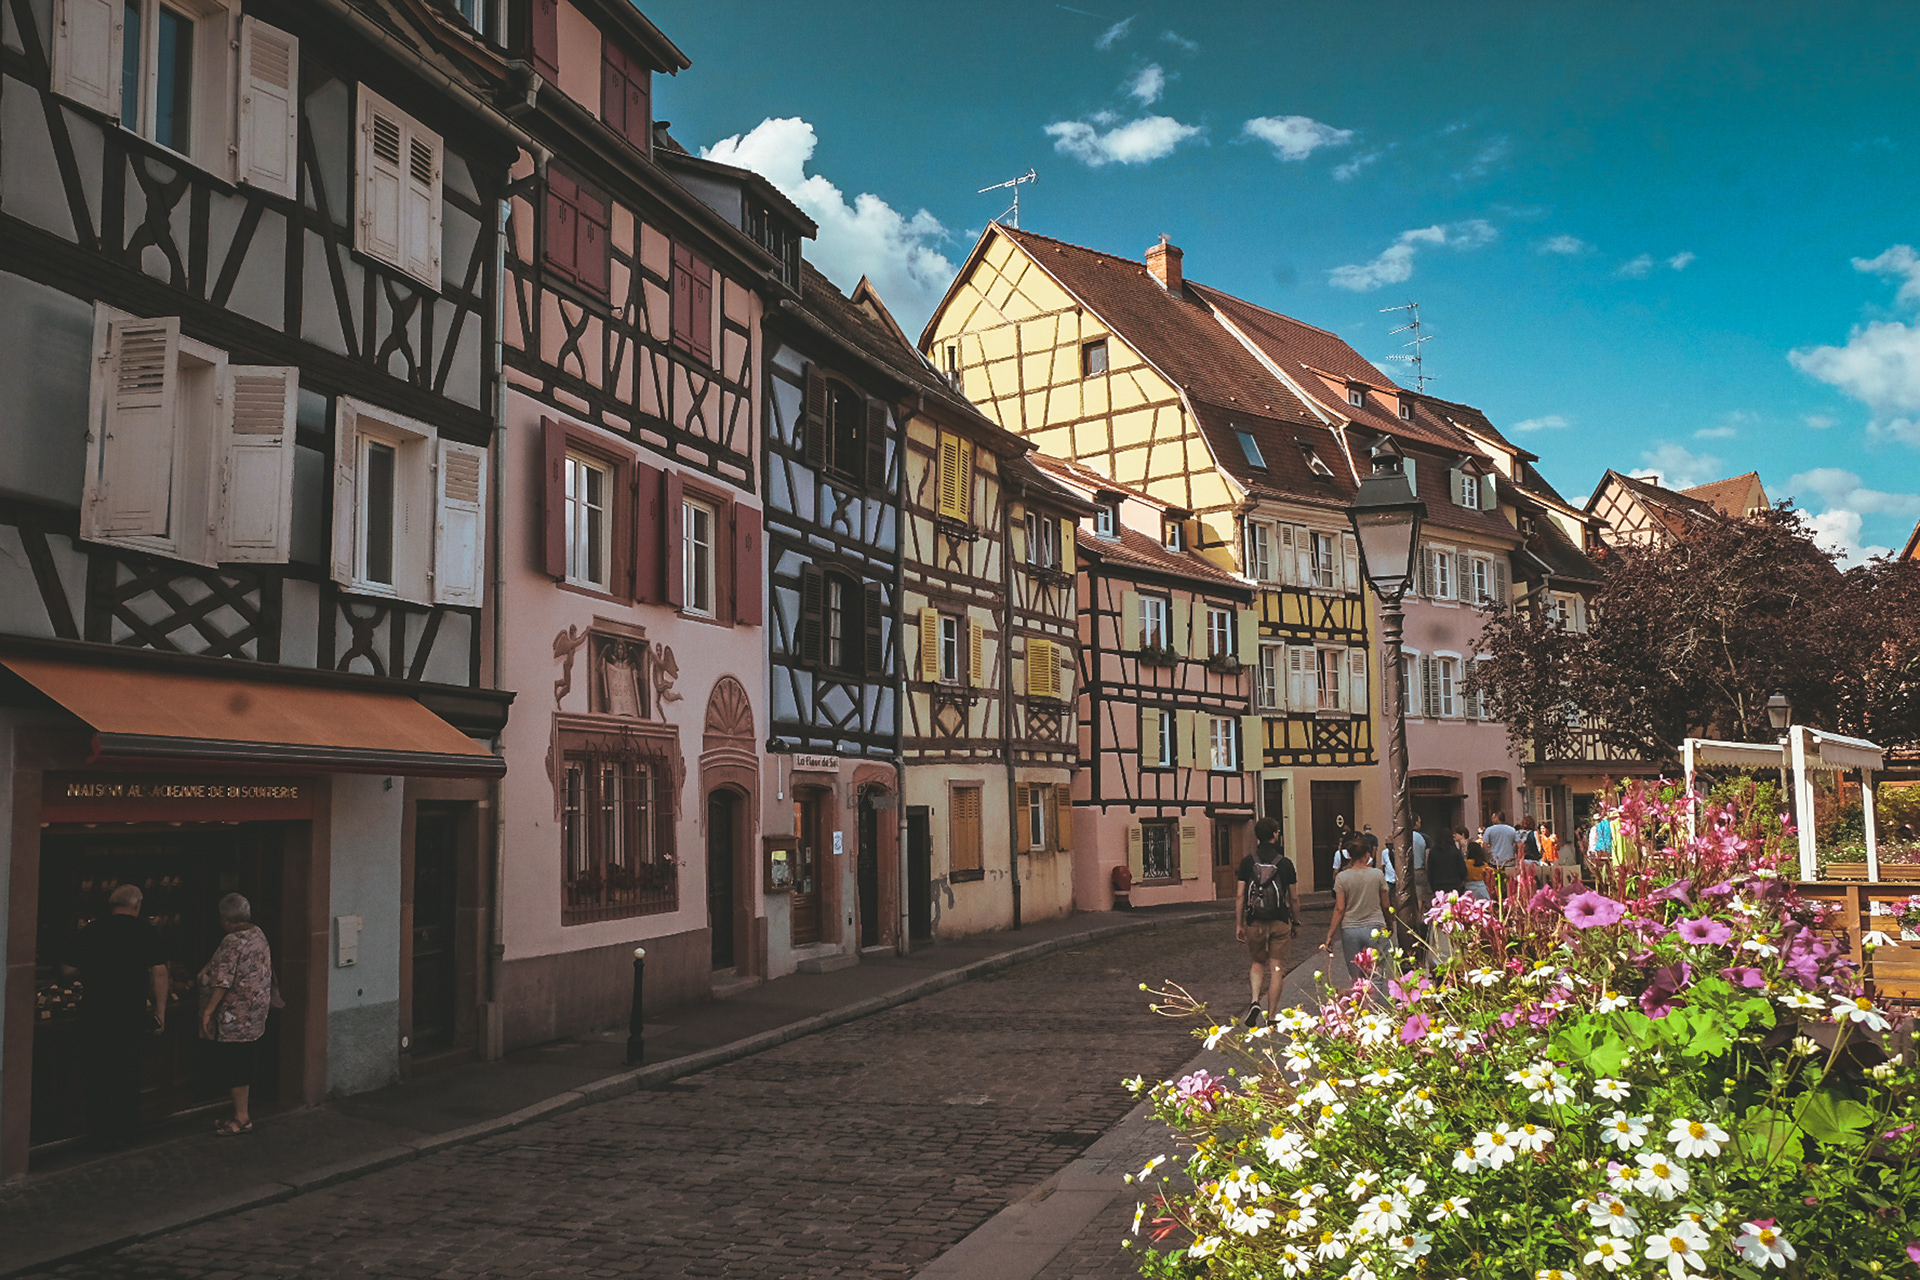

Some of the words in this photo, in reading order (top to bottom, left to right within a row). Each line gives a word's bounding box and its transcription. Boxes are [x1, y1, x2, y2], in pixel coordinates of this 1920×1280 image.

[67, 783, 123, 797] MAISON
[127, 784, 205, 798] ALACIENNE
[207, 785, 225, 798] DE
